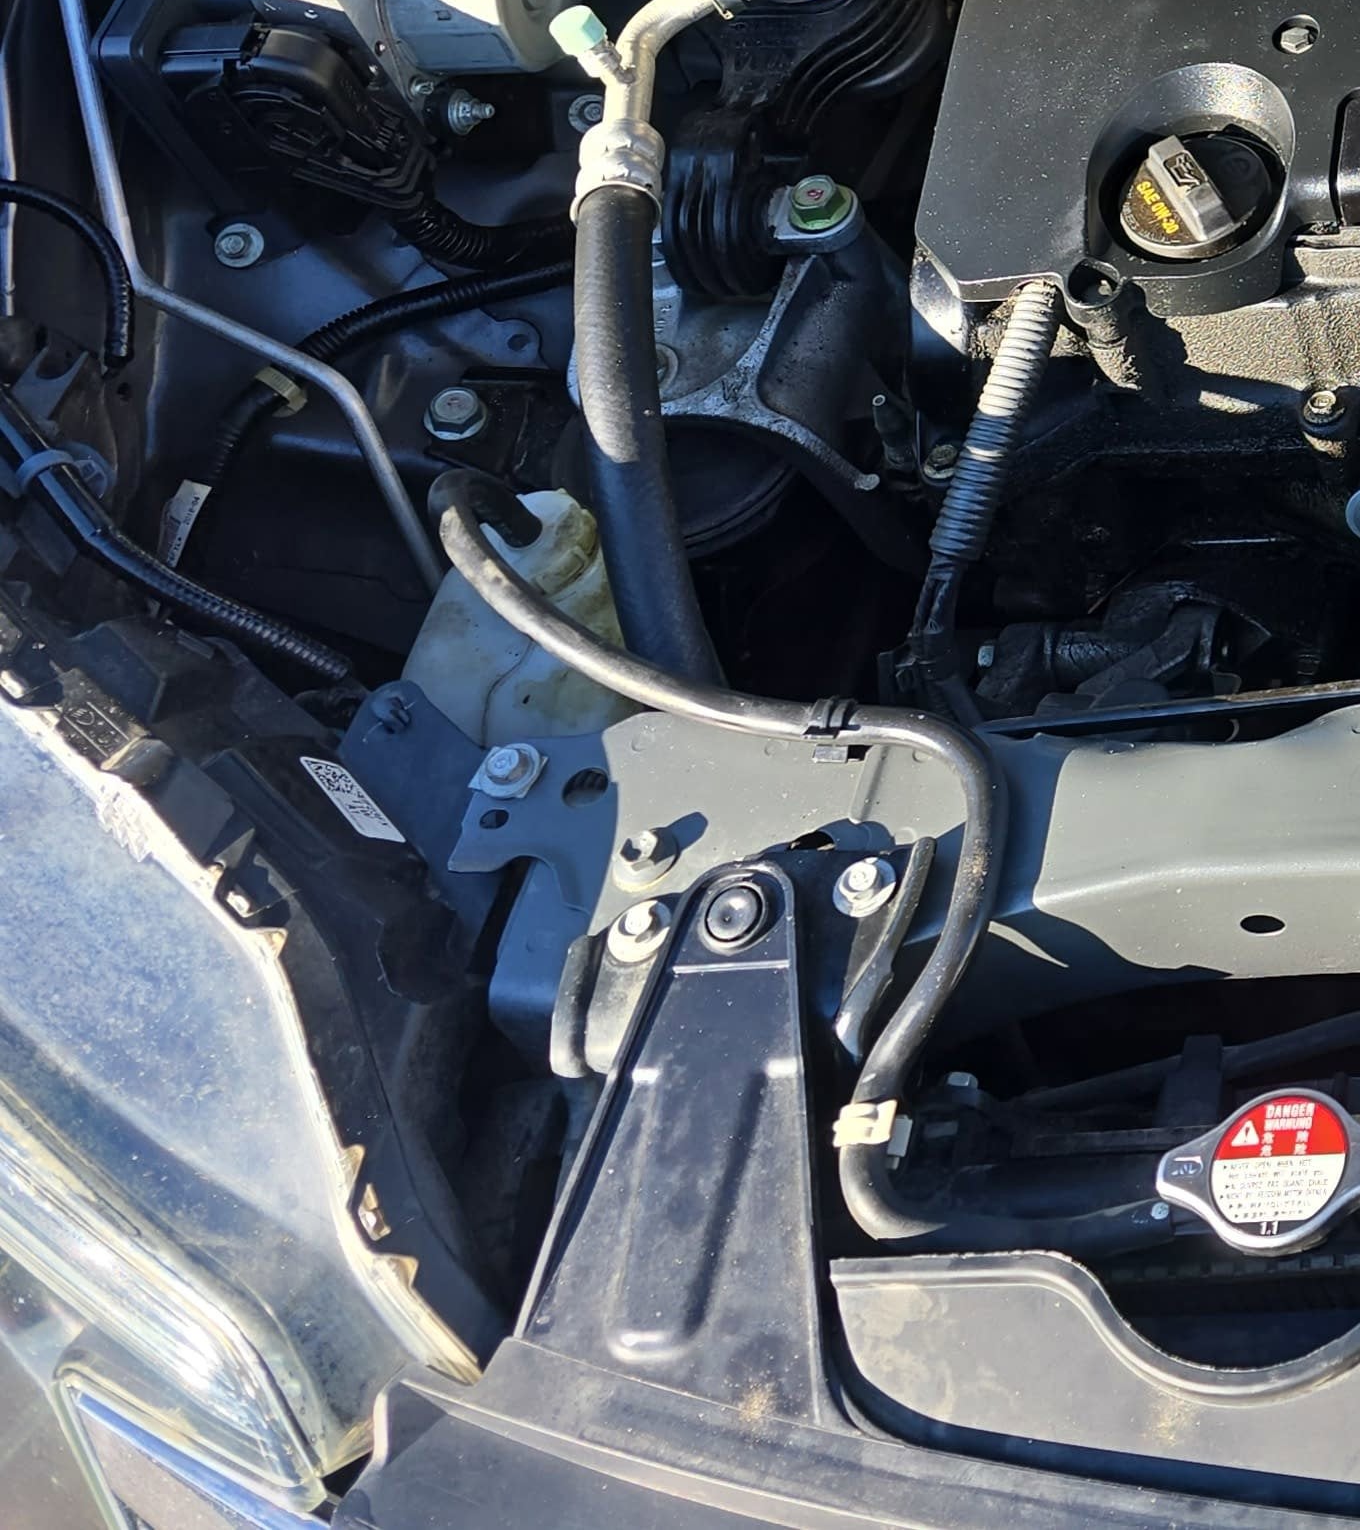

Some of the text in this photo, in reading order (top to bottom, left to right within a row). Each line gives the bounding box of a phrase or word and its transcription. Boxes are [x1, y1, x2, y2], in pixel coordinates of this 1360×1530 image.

[1136, 181, 1160, 205] SAE
[1151, 201, 1180, 235] 0W-20
[1266, 1103, 1316, 1119] DANGER
[1259, 1221, 1279, 1235] 1.1
